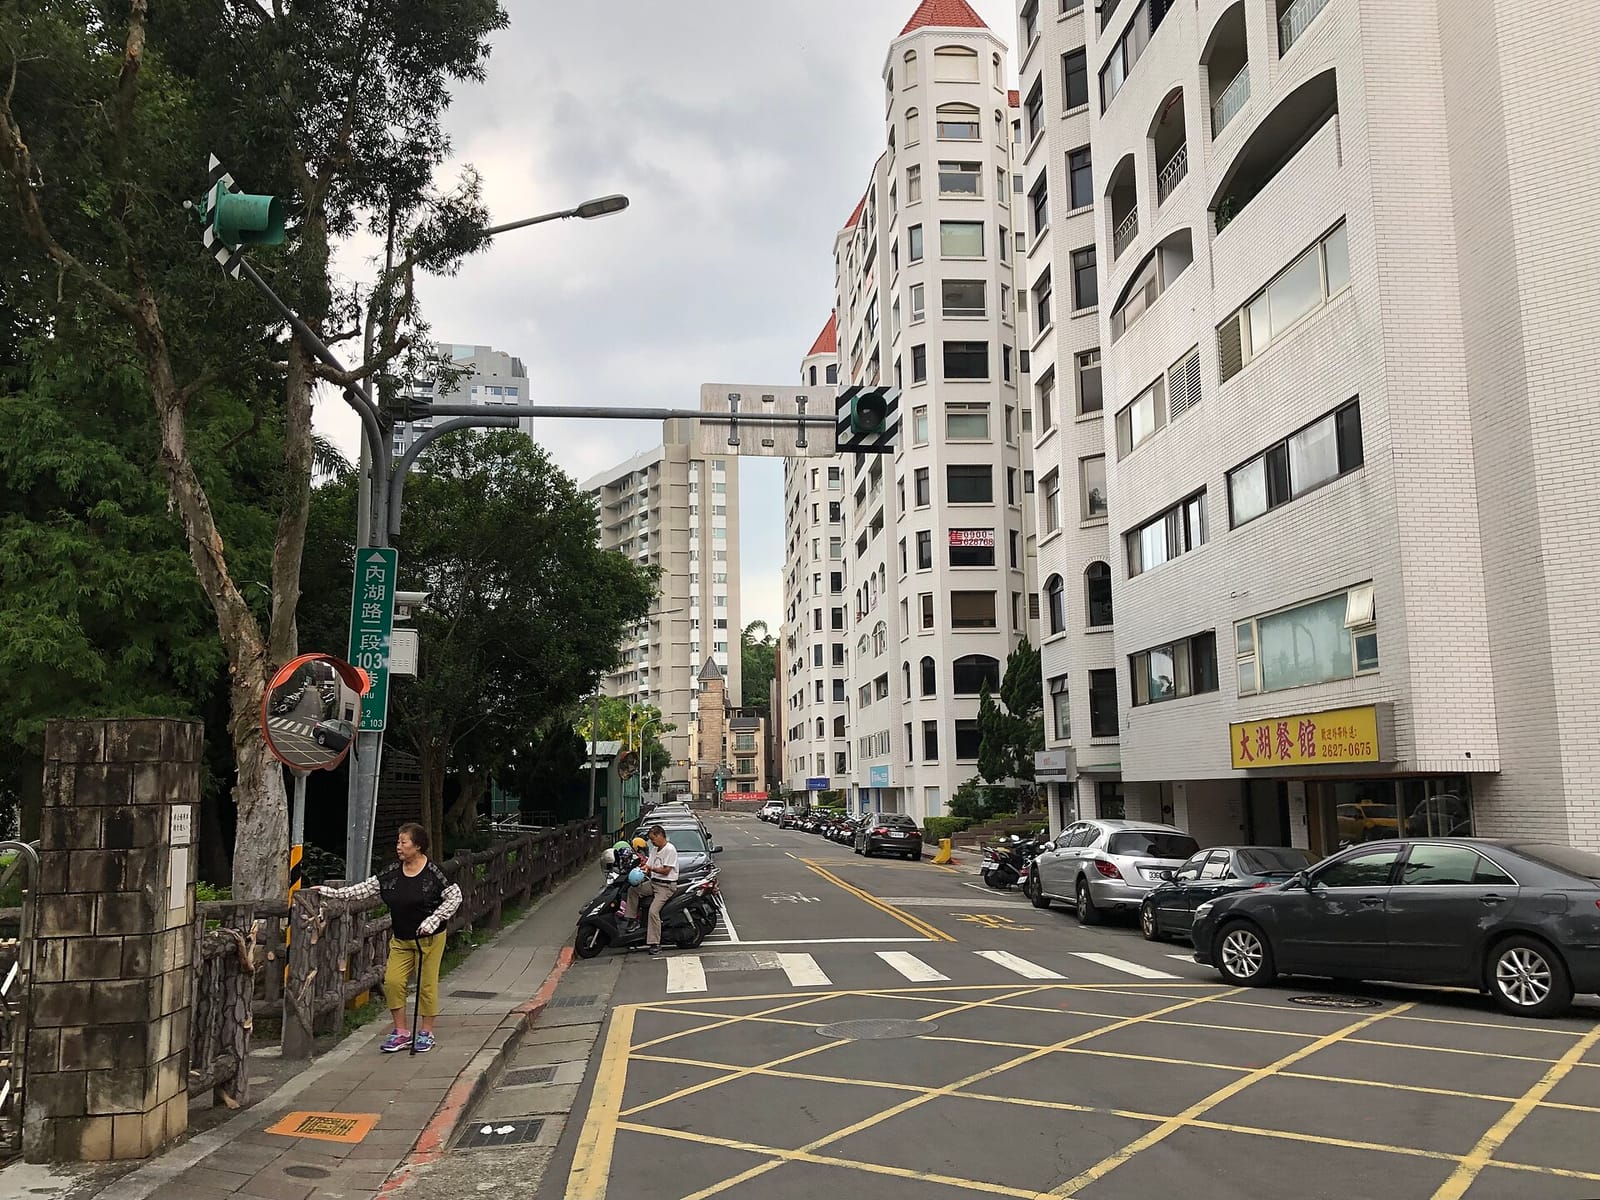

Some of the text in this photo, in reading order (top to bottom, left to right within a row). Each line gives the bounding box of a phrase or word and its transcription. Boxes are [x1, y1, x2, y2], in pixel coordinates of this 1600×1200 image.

[1240, 719, 1316, 762] 大湖餐館
[1322, 742, 1371, 757] 2627-0675
